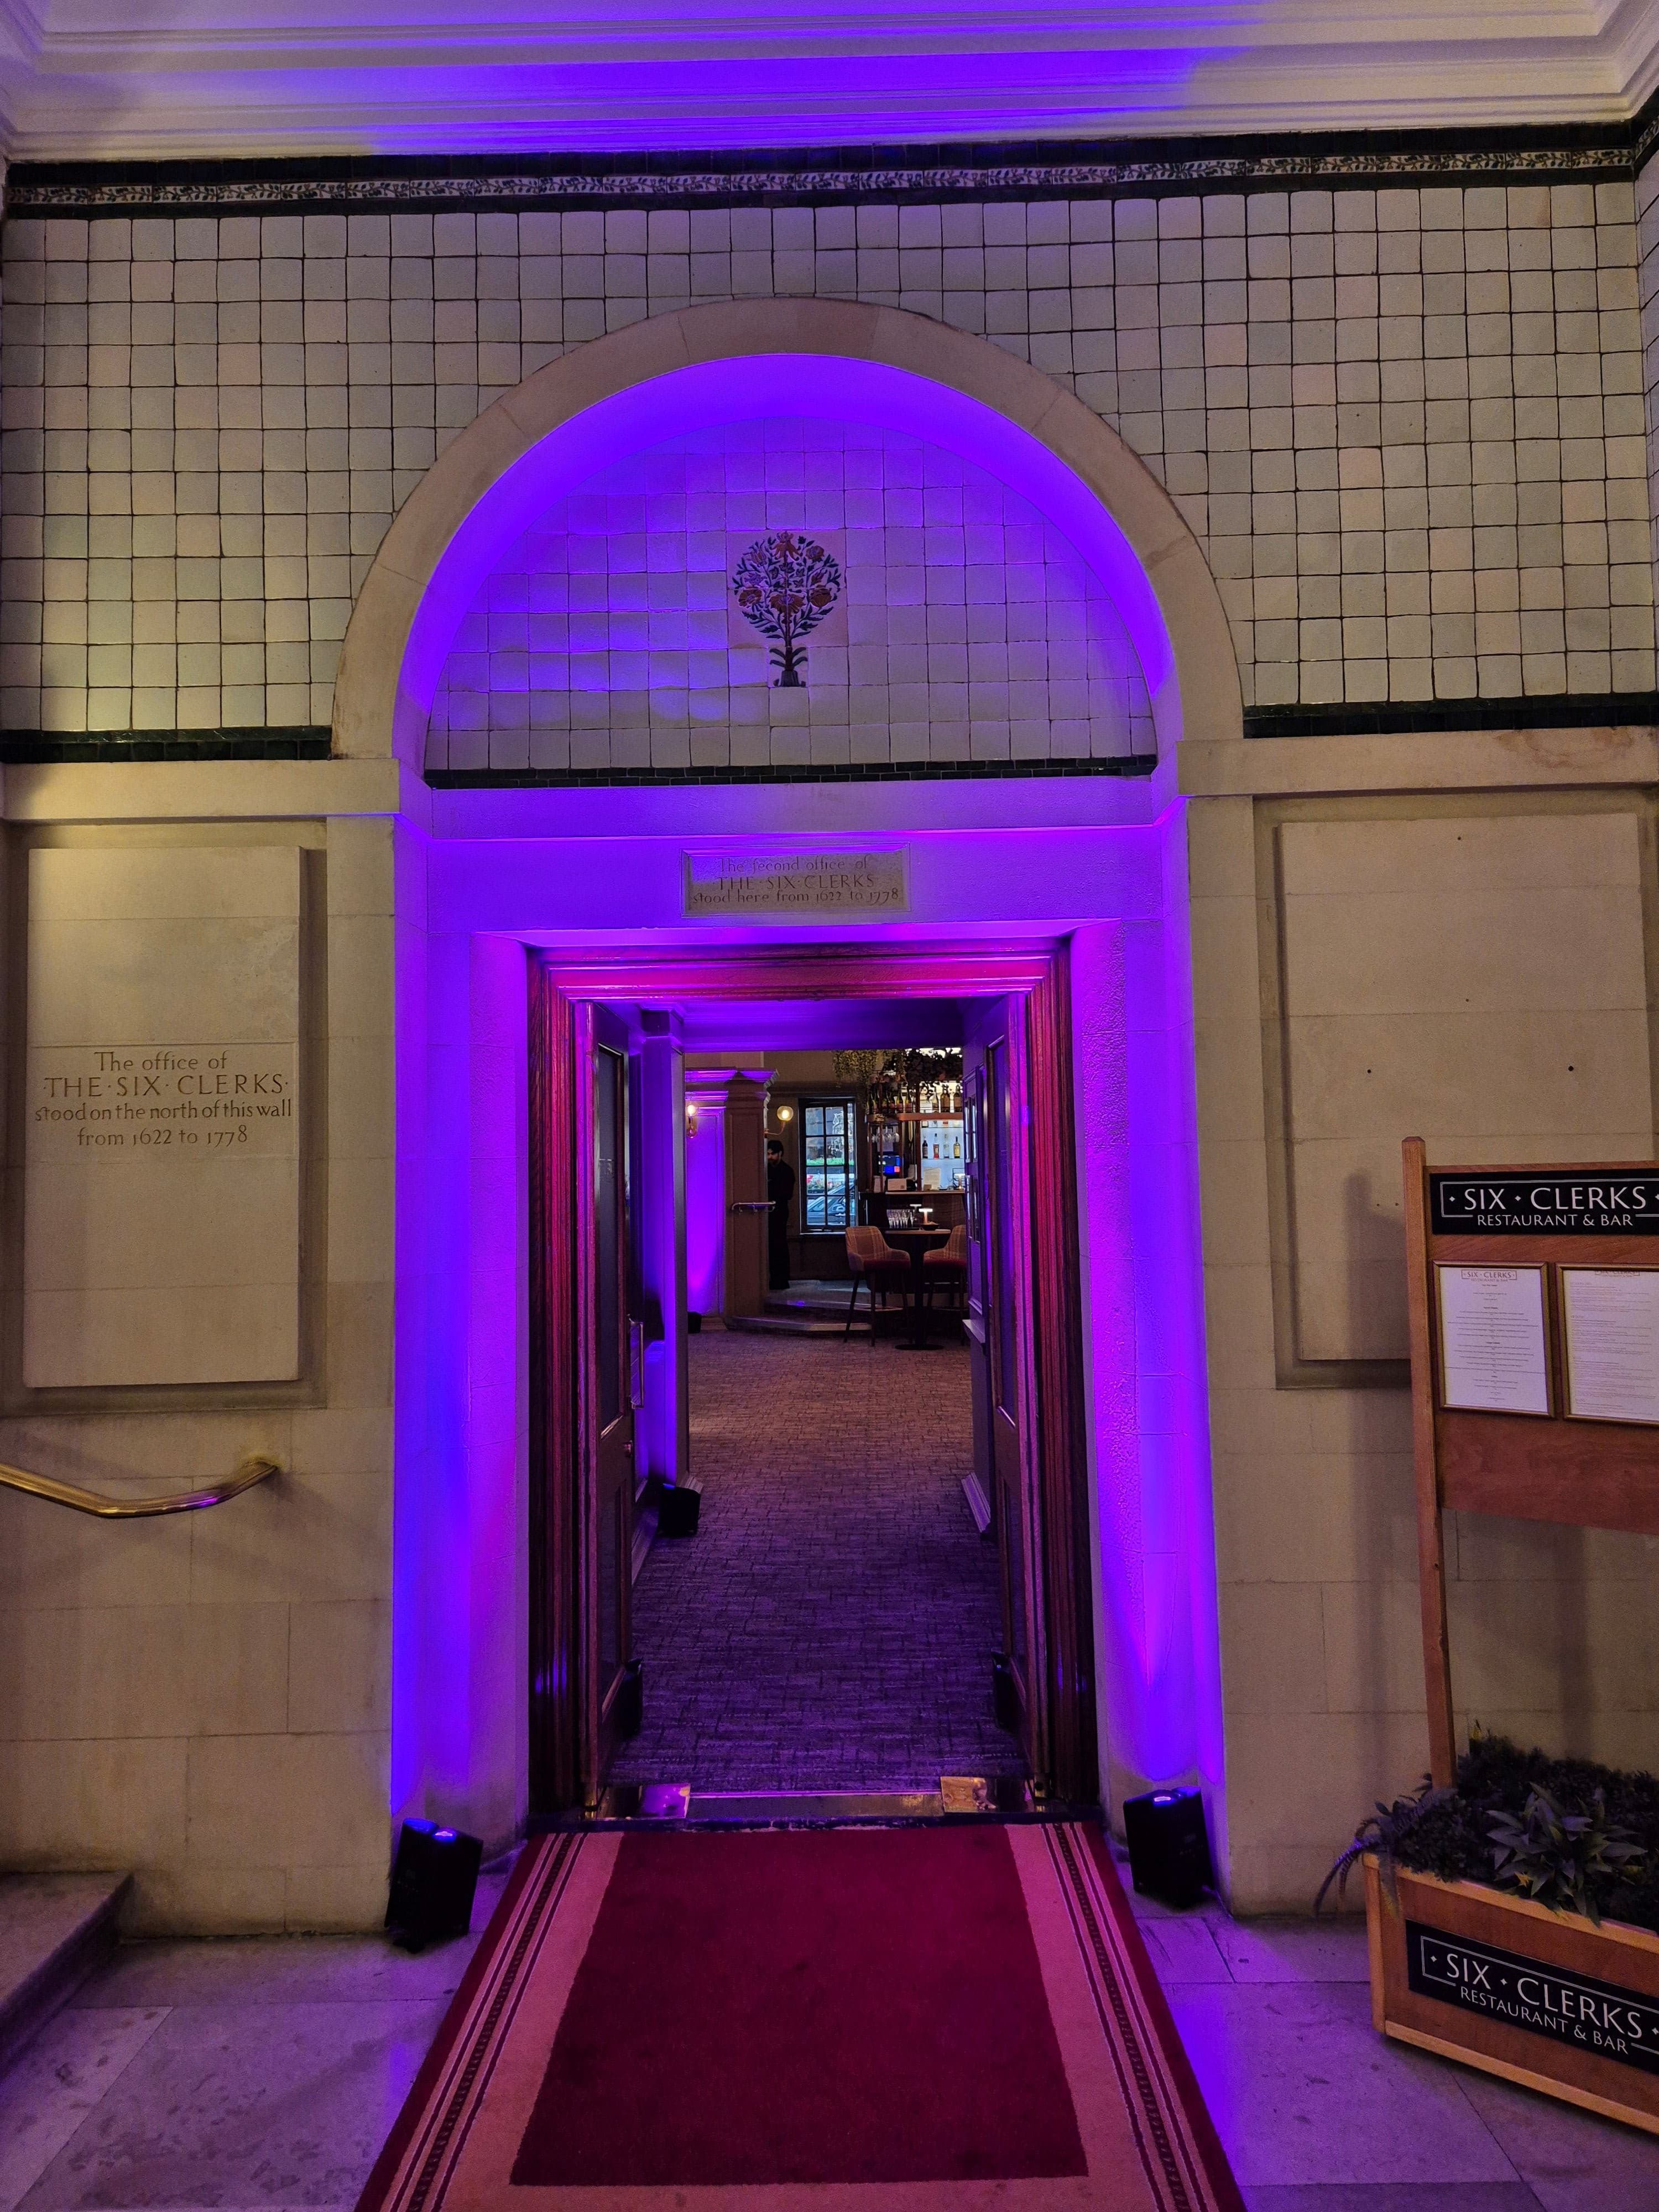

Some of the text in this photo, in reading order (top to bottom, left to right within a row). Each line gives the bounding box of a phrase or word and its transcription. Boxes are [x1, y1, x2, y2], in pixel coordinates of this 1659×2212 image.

[719, 857, 744, 872] The
[806, 855, 845, 870] office
[855, 854, 872, 869] of
[718, 874, 874, 890] THE SIX CLERKS
[693, 887, 899, 906] stood here from 1622 to 1778
[94, 1050, 229, 1072] The office of
[44, 1073, 283, 1098] THE SIX CLERKS
[35, 1098, 291, 1121] stood on the north of this wall
[77, 1125, 248, 1147] from 1622 to 1778
[1464, 1186, 1646, 1210] SIX CLERKS
[1477, 1214, 1634, 1226] RESTAURANT & BAR
[1446, 1953, 1642, 2039] SIX CLERKS
[1460, 1986, 1629, 2054] RESTAURANT & BAR
